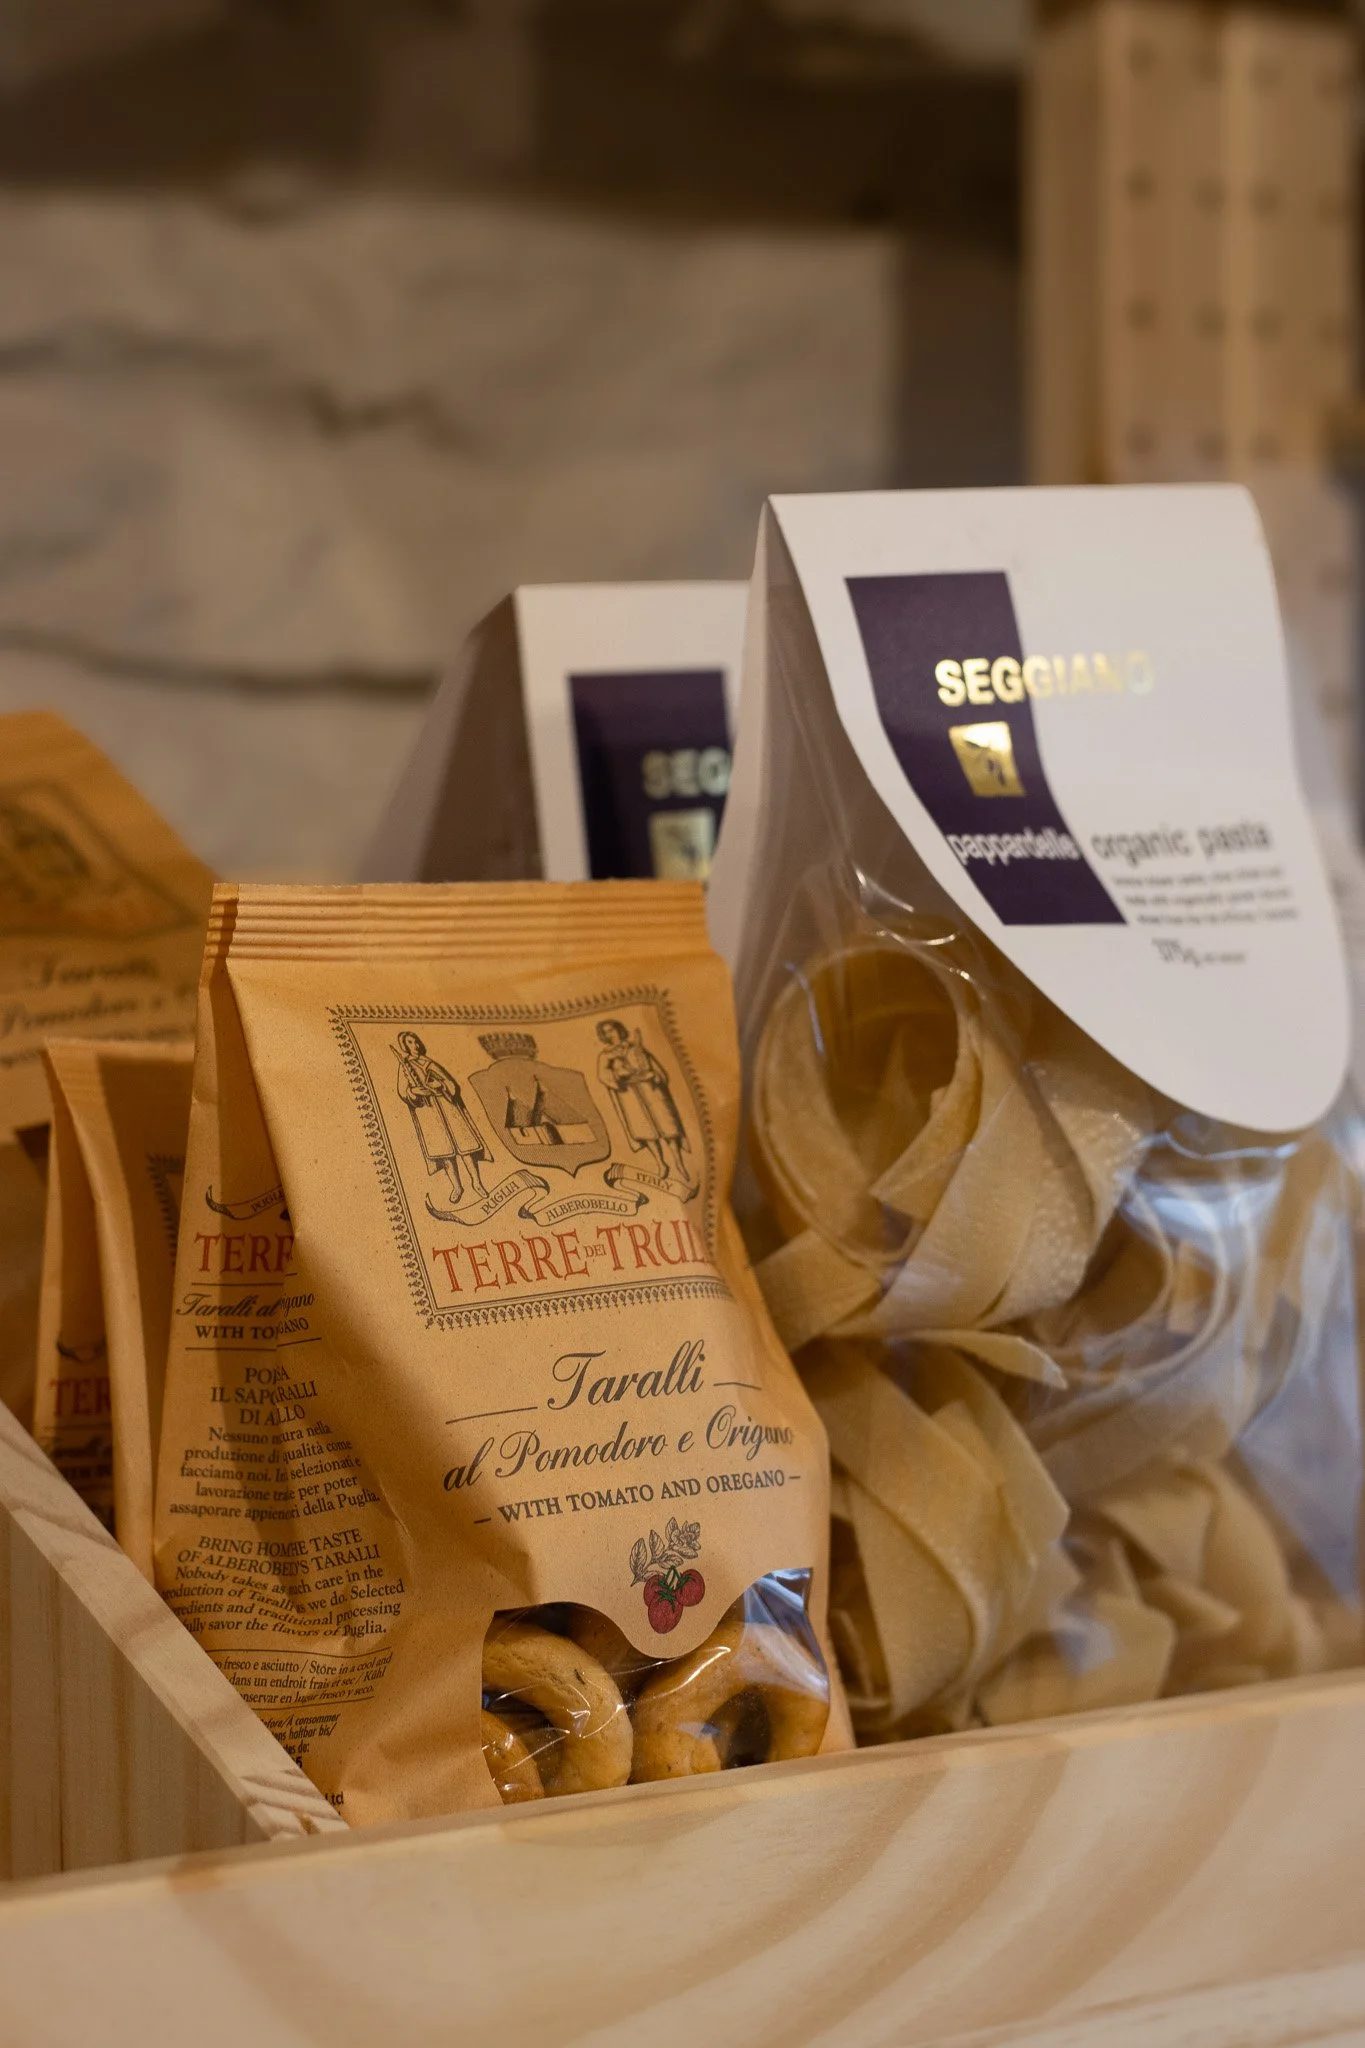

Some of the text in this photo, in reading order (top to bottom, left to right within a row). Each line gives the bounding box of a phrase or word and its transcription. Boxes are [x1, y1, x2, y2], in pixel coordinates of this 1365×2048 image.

[935, 651, 1155, 706] SEGGIANO
[1092, 824, 1191, 867] organic
[1198, 819, 1270, 861] pasta
[636, 1173, 673, 1191] ITALY
[481, 1180, 521, 1215] PUGLIA
[546, 1199, 629, 1222] ALBEROBELLO
[193, 1231, 295, 1273] TERR
[432, 1218, 706, 1294] TERRE DEI TRUL
[176, 1292, 258, 1317] Taralli
[195, 1325, 244, 1339] WITH
[547, 1338, 705, 1411] Taralli
[240, 1408, 259, 1425] DI
[208, 1426, 269, 1444] Nessuno
[443, 1404, 793, 1492] al Pomodoro e Origano
[184, 1446, 266, 1463] produzione
[282, 1442, 324, 1465] qualità
[326, 1440, 353, 1454] come
[180, 1462, 244, 1480] facciamo
[246, 1469, 273, 1482] noi.
[196, 1481, 271, 1500] lavorazione
[298, 1484, 320, 1500] per
[323, 1476, 358, 1495] poter
[498, 1469, 786, 1523] WITH TOMATO AND OREGANO
[169, 1503, 242, 1518] assaporare
[303, 1497, 336, 1517] della
[336, 1488, 381, 1508] Puglia.
[198, 1536, 253, 1555] BRING
[310, 1528, 363, 1553] TASTE
[177, 1550, 202, 1563] OF
[311, 1543, 380, 1571] TARALLI
[176, 1566, 228, 1583] Nobody
[232, 1576, 269, 1591] takes
[315, 1575, 343, 1591] care
[346, 1568, 360, 1583] in
[363, 1563, 384, 1580] the
[227, 1587, 245, 1597] of
[307, 1598, 327, 1612] we
[350, 1578, 405, 1600] Selected
[226, 1603, 254, 1614] and
[258, 1609, 333, 1626] traditional
[336, 1600, 401, 1626] processing
[208, 1619, 241, 1631] savor
[245, 1617, 268, 1631] the
[272, 1621, 319, 1637] flavors
[342, 1619, 387, 1638] Puglia.
[223, 1656, 251, 1671] fresco
[253, 1660, 259, 1670] e
[261, 1658, 300, 1673] asciutto
[309, 1660, 337, 1675] Store
[339, 1663, 349, 1675] in
[229, 1672, 251, 1687] dans
[254, 1676, 267, 1687] un
[270, 1674, 307, 1690] endroit
[309, 1676, 330, 1690] frais
[280, 1695, 292, 1704] en
